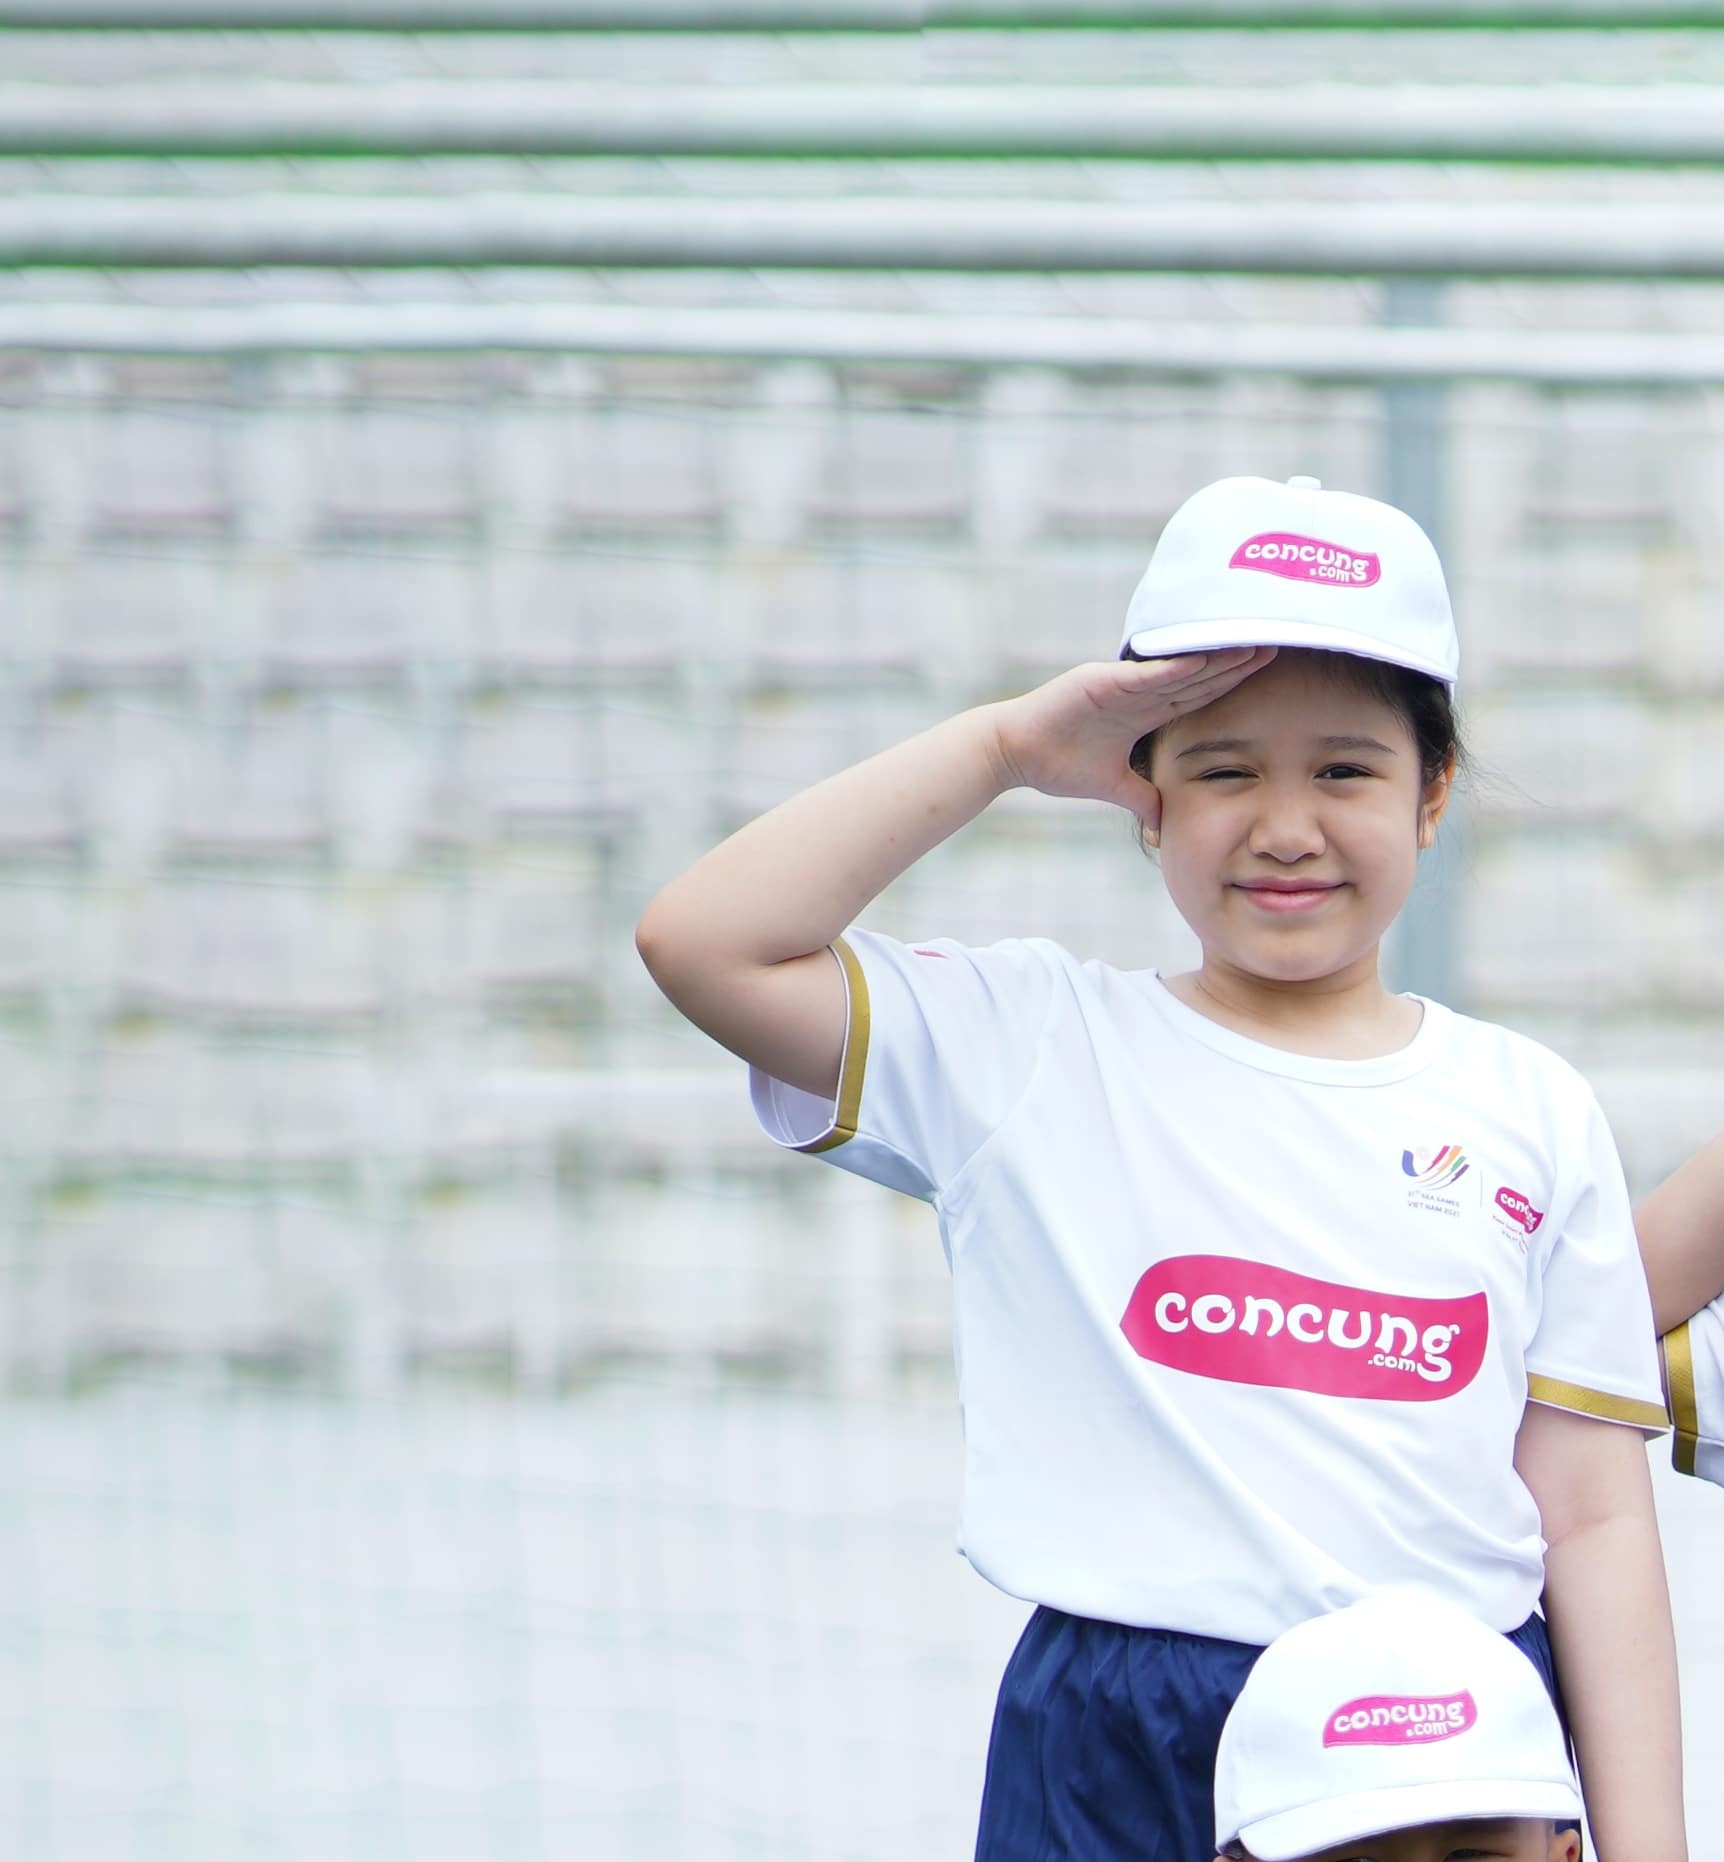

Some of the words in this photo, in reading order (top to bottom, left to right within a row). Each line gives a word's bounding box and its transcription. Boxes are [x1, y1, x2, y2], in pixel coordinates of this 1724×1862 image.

[1244, 543, 1370, 581] concung
[1309, 566, 1350, 582] .com
[1154, 1292, 1460, 1383] concung
[1367, 1354, 1416, 1371] .com
[1333, 1701, 1466, 1733] concung
[1405, 1722, 1448, 1737] .com
